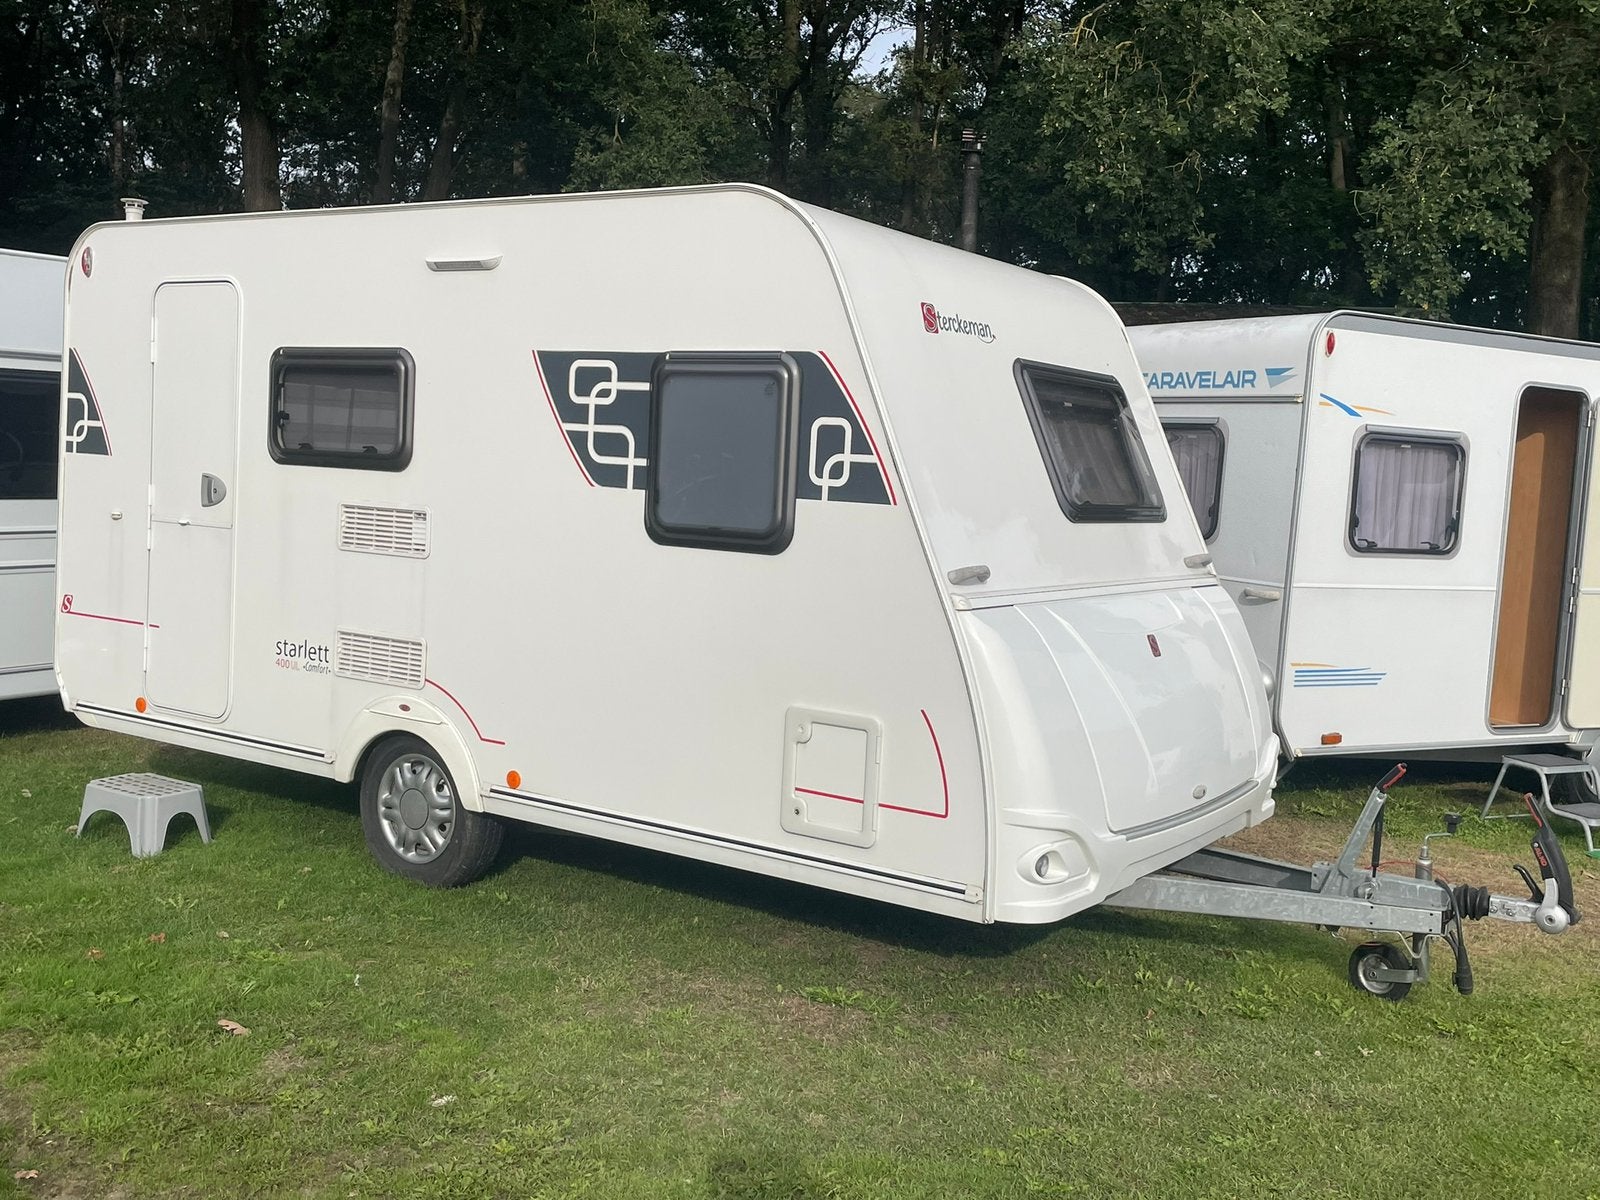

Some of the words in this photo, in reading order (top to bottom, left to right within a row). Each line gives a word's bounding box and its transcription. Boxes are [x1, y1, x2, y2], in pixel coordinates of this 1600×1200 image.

[921, 302, 993, 339] Sterckeman
[1143, 370, 1257, 390] ARAVELAIR
[275, 639, 330, 663] starlett
